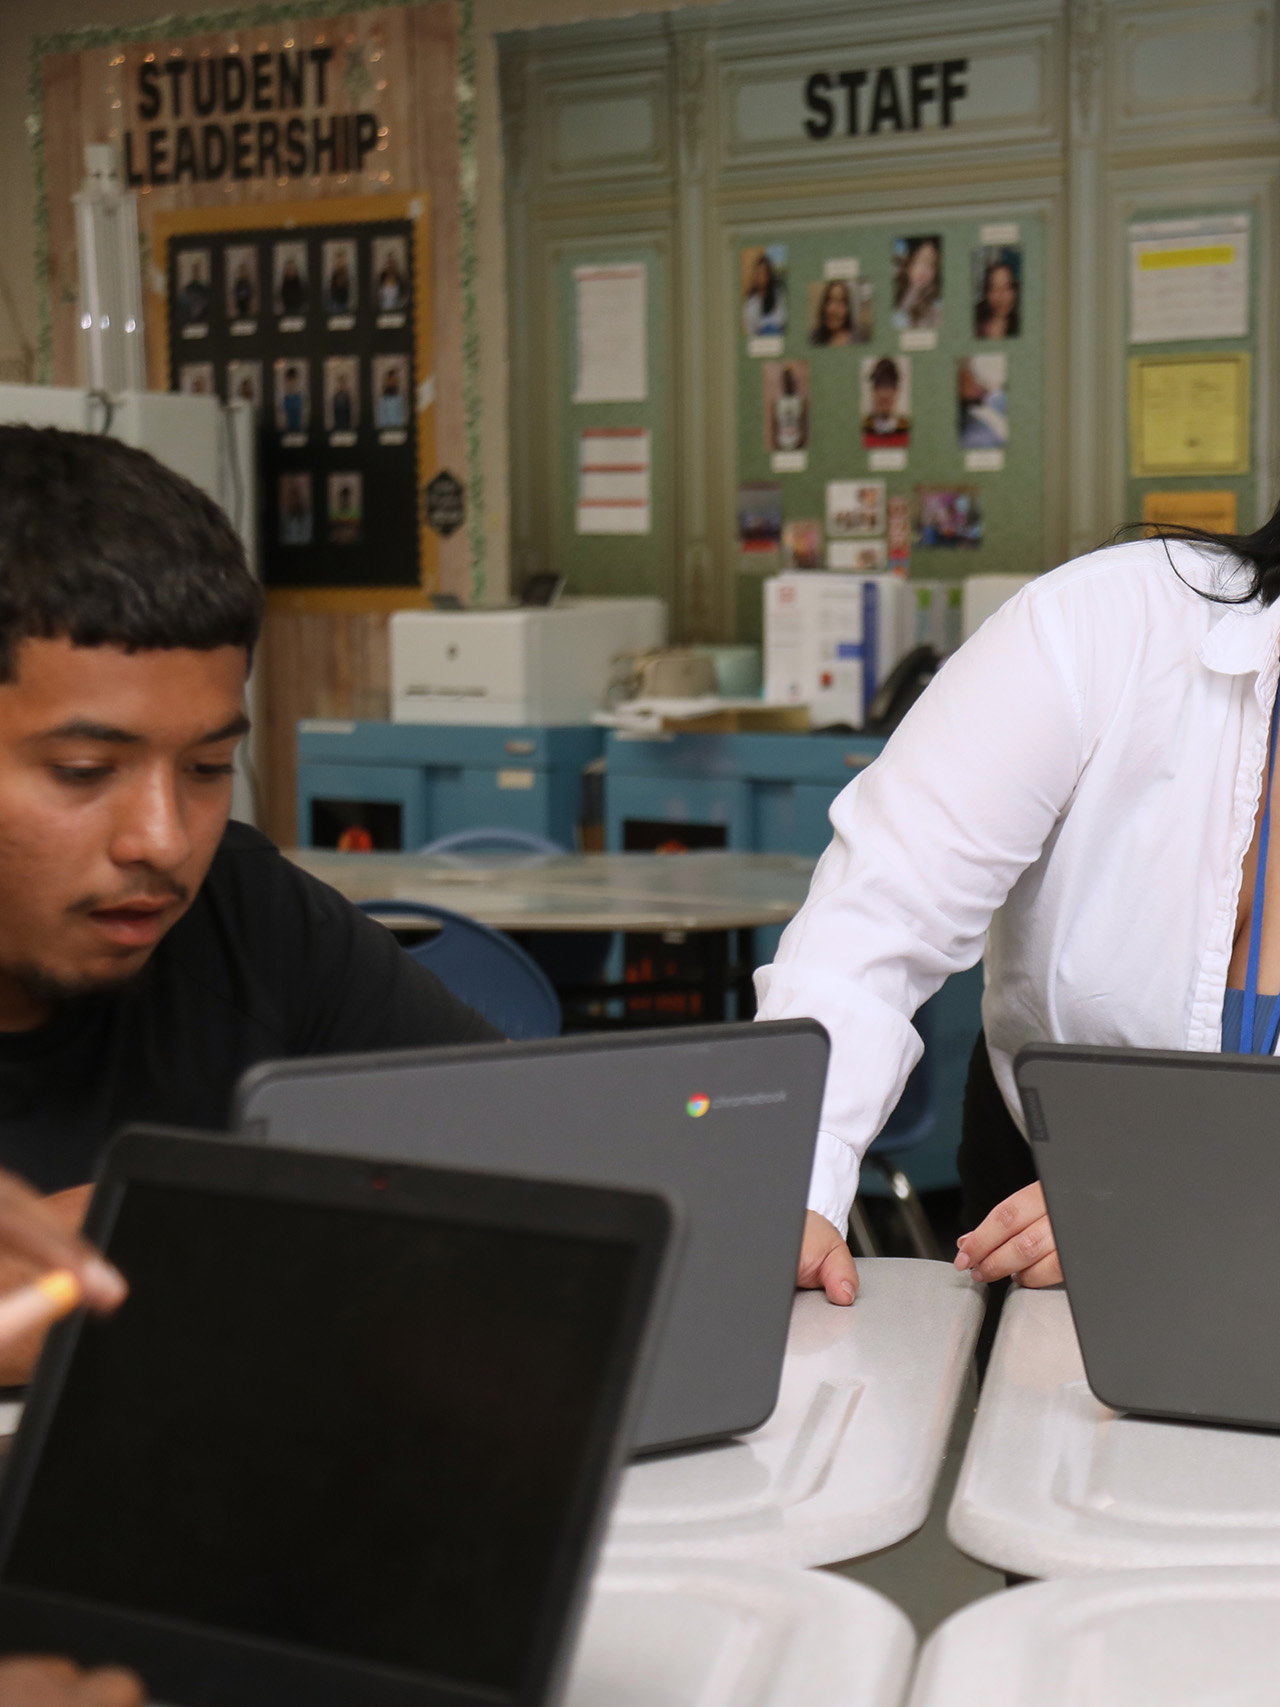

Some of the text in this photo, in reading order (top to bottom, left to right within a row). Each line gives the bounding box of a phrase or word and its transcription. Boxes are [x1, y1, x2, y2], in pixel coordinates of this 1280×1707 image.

[137, 48, 334, 119] STUDENT
[804, 58, 970, 141] STAFF
[123, 113, 378, 189] LEADERSHIP
